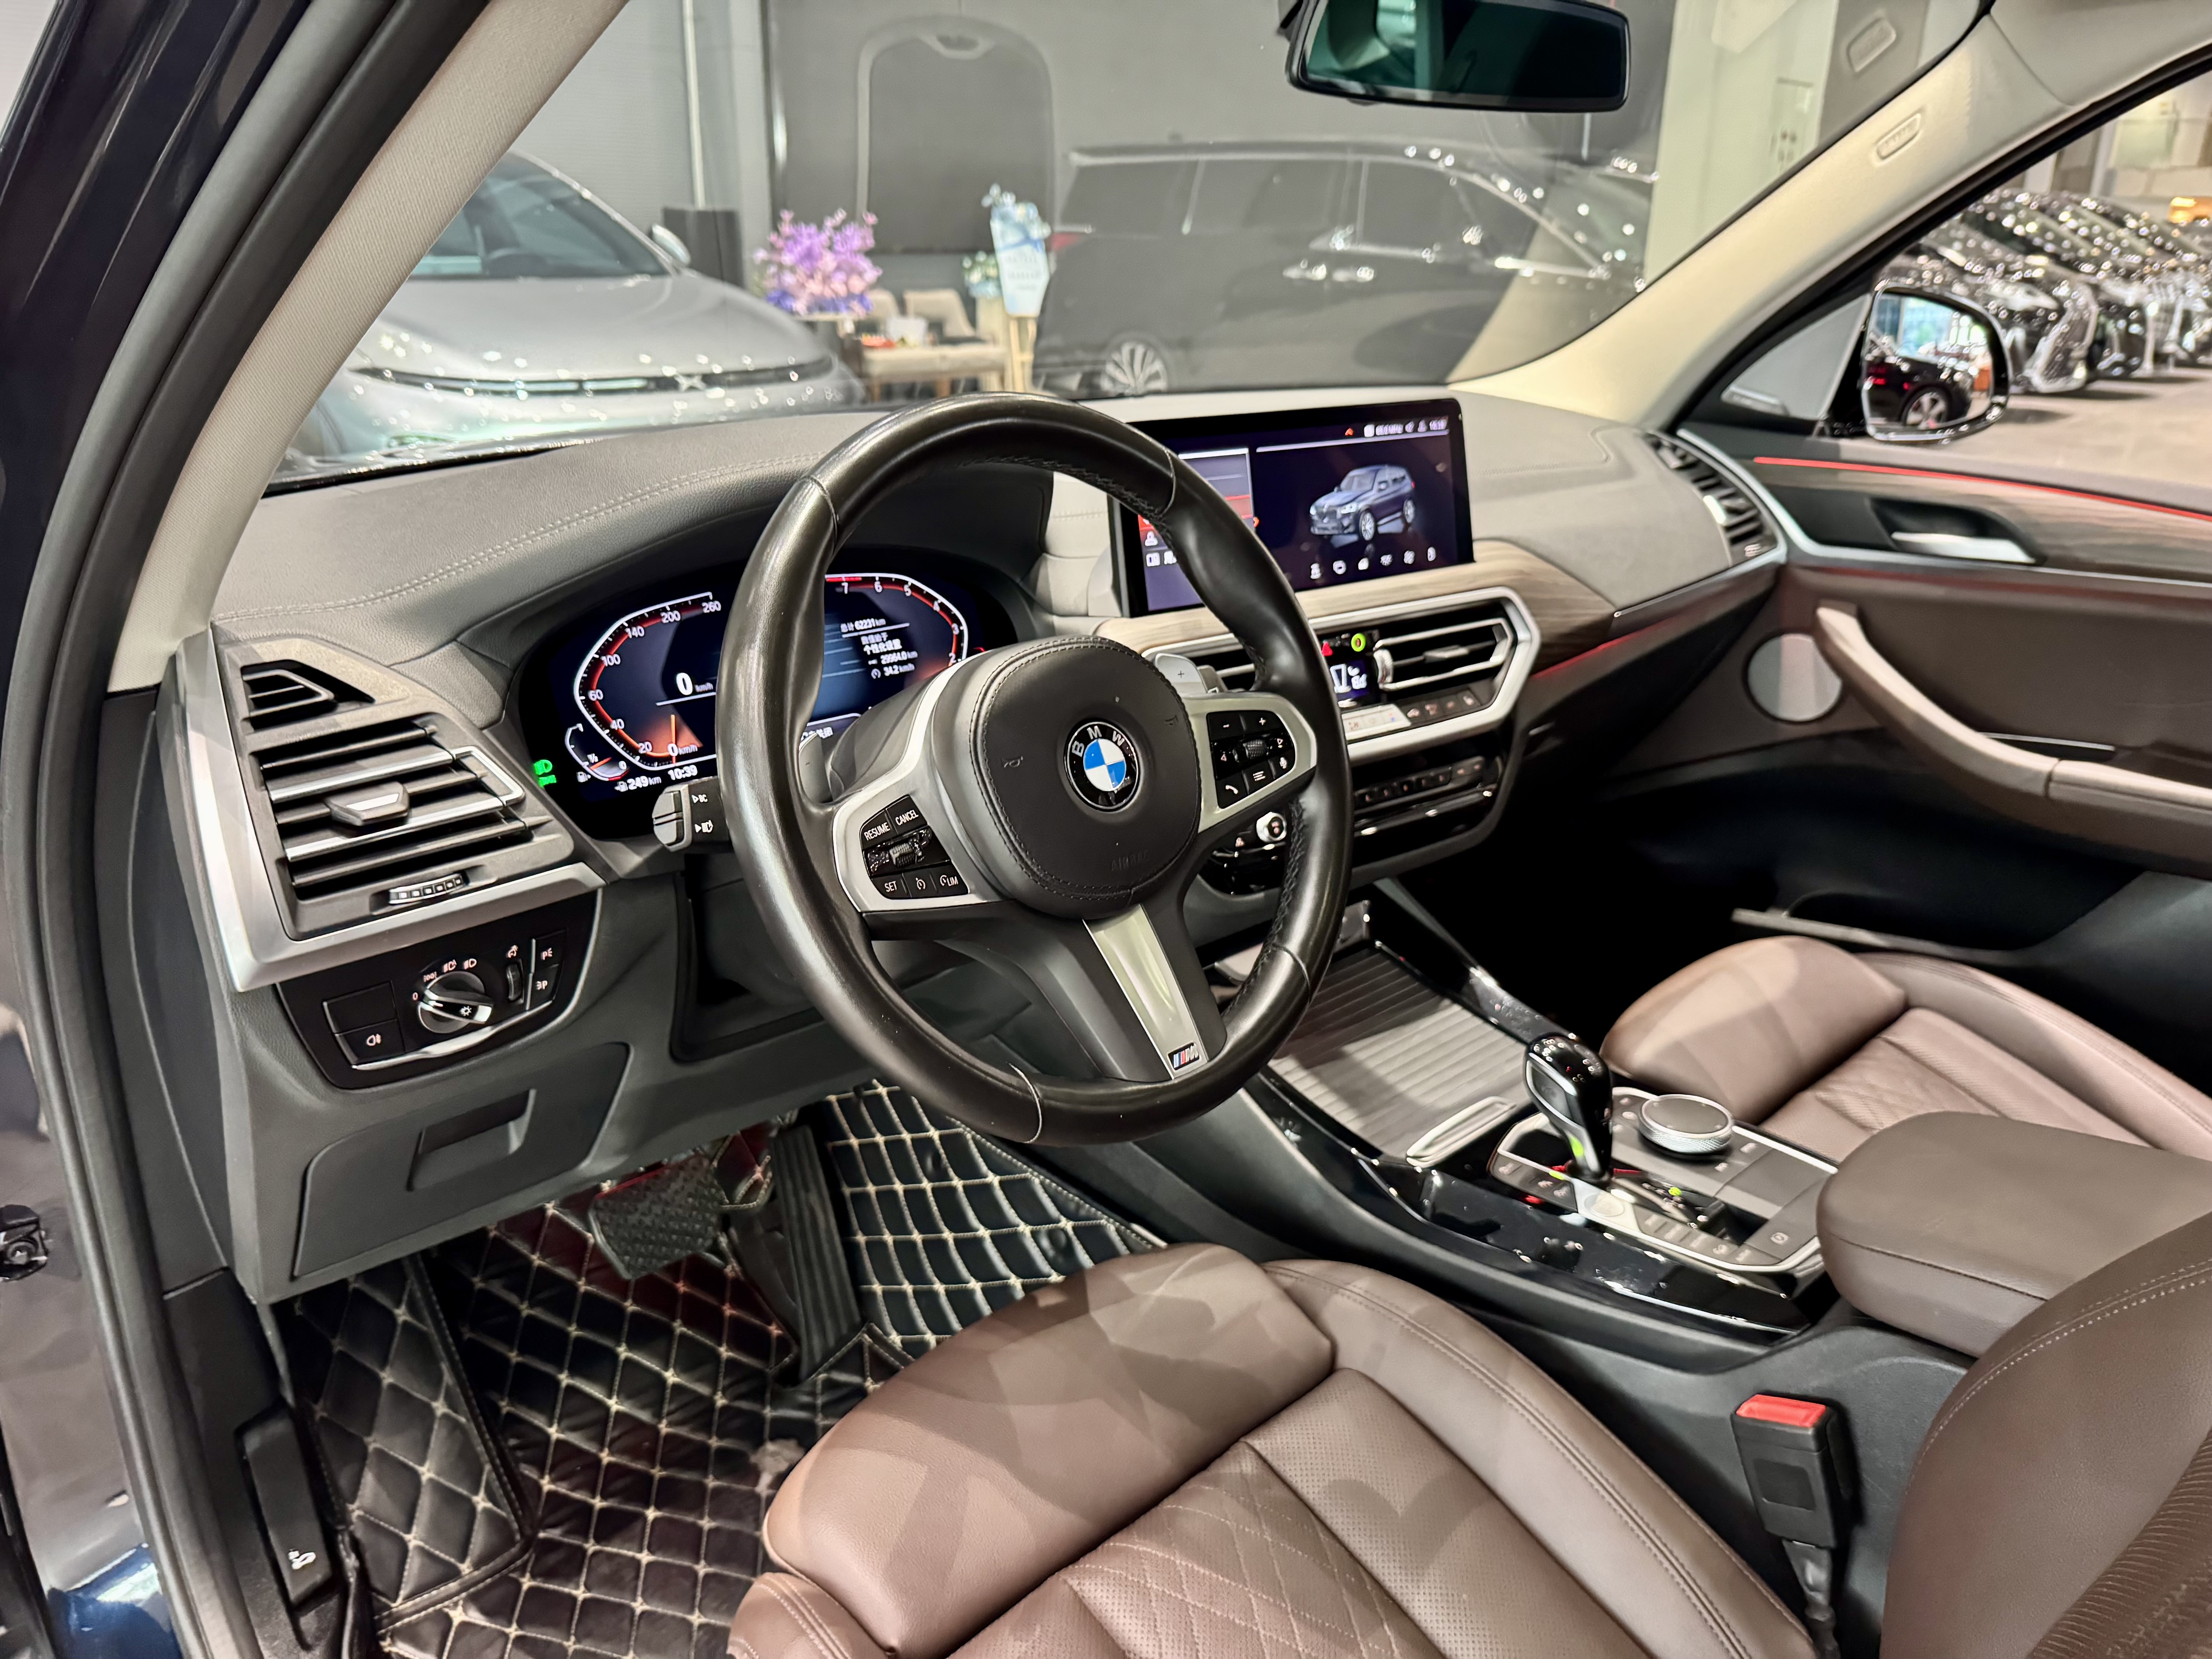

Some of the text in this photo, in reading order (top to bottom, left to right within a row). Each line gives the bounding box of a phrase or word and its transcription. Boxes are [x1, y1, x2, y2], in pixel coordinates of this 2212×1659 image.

[842, 582, 848, 594] 7
[874, 581, 883, 593] 6
[904, 584, 912, 596] 5
[701, 600, 721, 613] 260
[933, 601, 940, 612] 4
[661, 610, 681, 623] 200
[625, 626, 645, 638] 140
[951, 623, 959, 635] 3
[601, 654, 621, 666] 100
[949, 653, 957, 663] 2
[676, 673, 713, 696] 0 km/h
[588, 689, 603, 701] 60
[610, 719, 625, 730] 40
[1072, 725, 1125, 757] BMW
[639, 741, 652, 754] 20
[667, 743, 698, 756] 0 km/h
[618, 761, 627, 770] 0
[668, 765, 698, 780] 10:39
[627, 776, 661, 790] 249 km
[895, 809, 919, 826] CANCEL
[864, 822, 891, 841] RESUME
[884, 881, 897, 892] SET
[946, 876, 958, 886] LIM
